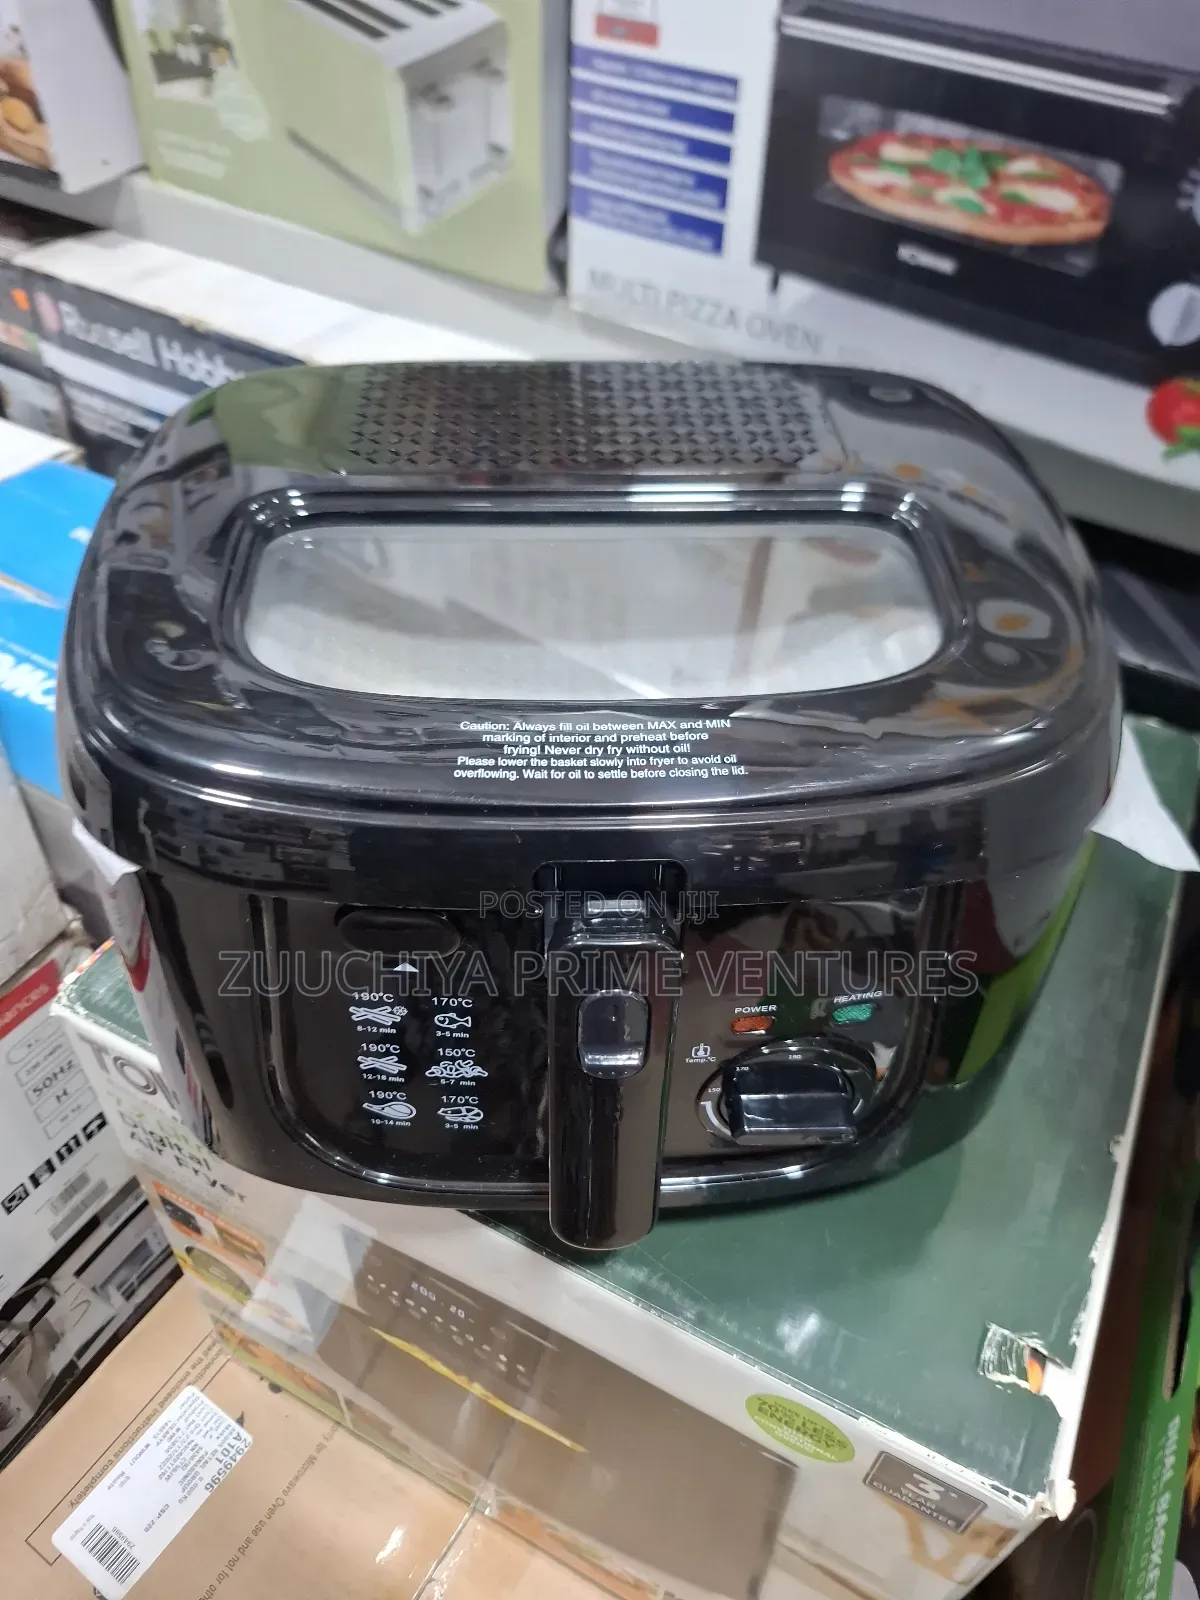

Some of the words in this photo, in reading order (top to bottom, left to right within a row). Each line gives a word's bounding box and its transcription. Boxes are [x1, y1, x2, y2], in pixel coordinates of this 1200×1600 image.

[746, 315, 822, 354] OVEN
[460, 721, 510, 731] Caution:
[514, 721, 556, 732] Always
[559, 721, 572, 730] fill
[576, 721, 590, 730] oil
[592, 721, 644, 730] between
[648, 721, 676, 729] MAX
[680, 720, 703, 729] and
[706, 719, 730, 728] MIN
[483, 732, 530, 744] marking
[534, 732, 546, 741] of
[549, 732, 592, 742] interior
[594, 732, 617, 742] and
[621, 731, 667, 743] preheat
[670, 731, 708, 741] before
[503, 744, 540, 756] frying!
[545, 745, 581, 755] Never
[585, 744, 603, 756] dry
[607, 744, 623, 756] fry
[626, 743, 669, 754] without
[673, 743, 690, 753] oil!
[457, 756, 495, 766] Please
[498, 756, 527, 766] lower
[530, 757, 547, 766] the
[551, 756, 587, 766] basket
[590, 756, 622, 768] slowly
[626, 756, 646, 766] into
[650, 755, 674, 767] fryer
[678, 755, 688, 765] to
[692, 754, 721, 764] avoid
[724, 754, 736, 763] oil
[454, 767, 519, 780] overflowing.
[523, 768, 547, 779] Wait
[551, 769, 564, 779] for
[568, 769, 581, 779] oil
[584, 769, 595, 779] to
[598, 768, 627, 779] settle
[631, 767, 666, 778] before
[669, 766, 708, 779] closing
[711, 766, 729, 776] the
[732, 765, 748, 775] lid.
[352, 992, 394, 1002] 190°C
[432, 997, 473, 1008] 170°C
[834, 991, 883, 1004] HEATING
[735, 1005, 777, 1014] POWER
[361, 1043, 400, 1053] 190°C
[437, 1048, 476, 1057] 150°C
[388, 1075, 404, 1083] min
[369, 1090, 407, 1100] 190°C
[441, 1096, 479, 1104] 170°C
[119, 1110, 212, 1172] Digital
[173, 1154, 247, 1202] Fryer
[155, 1368, 192, 1409] enclosed
[111, 1405, 160, 1460] instructions
[214, 1431, 244, 1464] A101
[177, 1450, 208, 1486] PANASONIC
[202, 1437, 251, 1493] 2949596
[64, 1456, 114, 1511] completely.
[179, 1470, 200, 1493] GROUP
[281, 1453, 318, 1497] Microwave
[871, 1480, 957, 1528] GUARANTEE
[898, 1487, 936, 1510] YEAR
[263, 1496, 286, 1520] Oven
[251, 1519, 267, 1537] use
[237, 1536, 254, 1557] and
[224, 1554, 240, 1572] not
[215, 1570, 230, 1585] for
